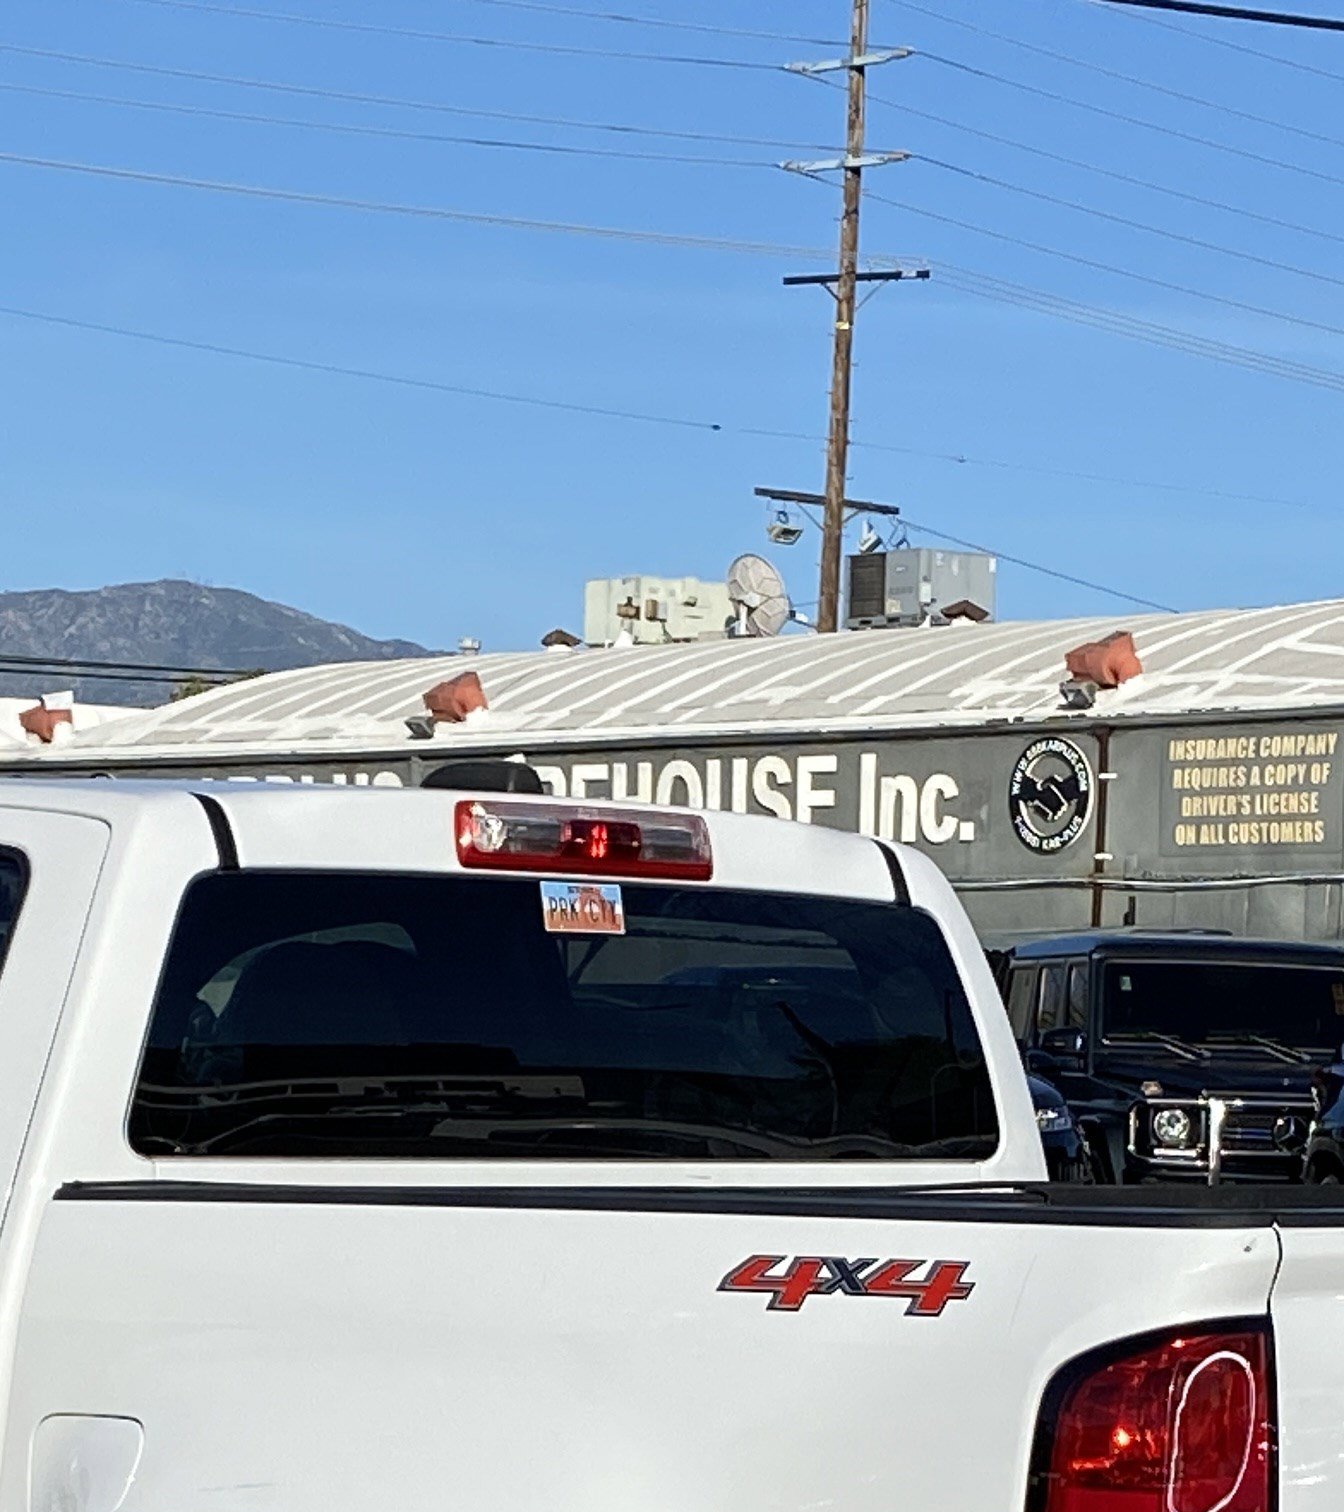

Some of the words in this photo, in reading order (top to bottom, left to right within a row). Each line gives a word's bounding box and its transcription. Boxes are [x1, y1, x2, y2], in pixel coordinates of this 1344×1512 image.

[1169, 737, 1256, 761] INSURANCE
[1259, 732, 1338, 758] COMPANY
[1173, 765, 1247, 791] REQUIRES
[1249, 765, 1261, 786] A
[1264, 763, 1306, 786] COPY
[1310, 762, 1331, 784] OF
[858, 752, 976, 844] Inc.
[1181, 794, 1251, 817] DRIVER'S
[1255, 791, 1320, 815] LICENSE
[1175, 824, 1196, 846] ON
[1199, 823, 1226, 845] ALL
[1228, 820, 1325, 844] CUSTOMERS
